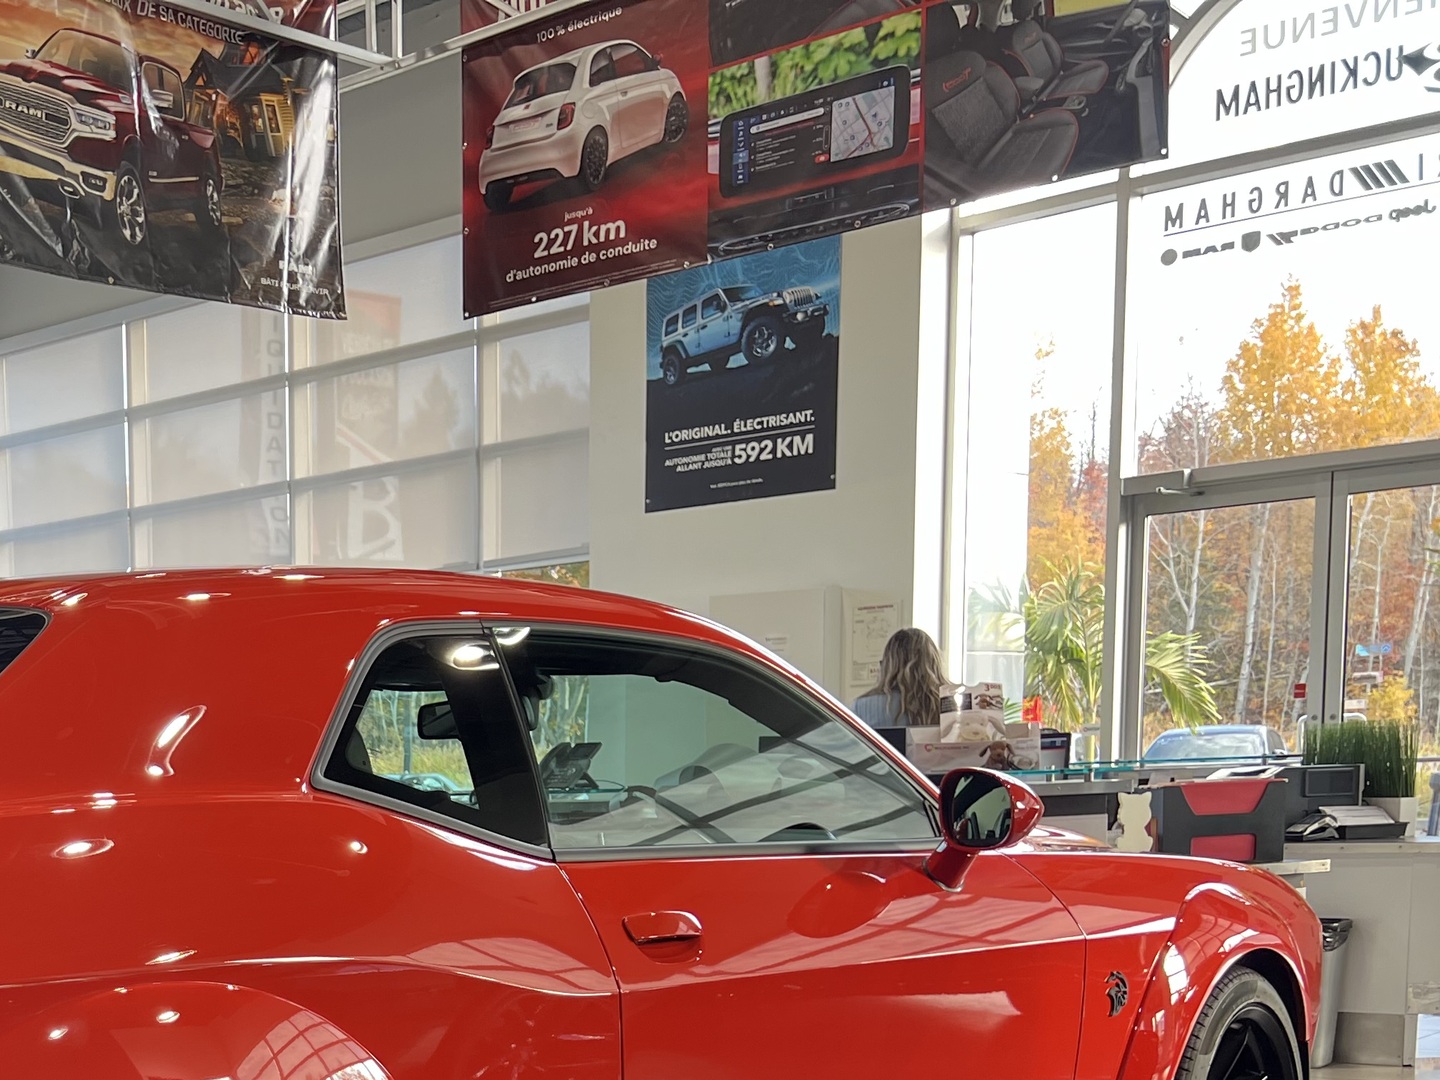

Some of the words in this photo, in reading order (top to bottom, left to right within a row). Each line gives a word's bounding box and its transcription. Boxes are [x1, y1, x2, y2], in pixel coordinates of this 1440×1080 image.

[136, 0, 157, 18] DE
[160, 7, 176, 25] SA
[536, 27, 554, 43] 100
[555, 25, 565, 36] %
[567, 6, 623, 32] électrique
[5, 100, 42, 118] RAM
[564, 207, 593, 222] jusqu'à
[533, 223, 579, 259] 227
[582, 219, 626, 246] km
[505, 256, 579, 283] d'autonomie
[580, 249, 597, 264] de
[599, 237, 658, 260] conduite
[664, 423, 731, 443] L'ORIGINAL.
[733, 409, 815, 433] ÉLECTRISANT.
[664, 453, 706, 467] AUTONOMIE
[706, 449, 732, 460] TOTALE
[733, 439, 773, 464] 592
[776, 433, 814, 458] KM
[676, 462, 702, 472] ALLANT
